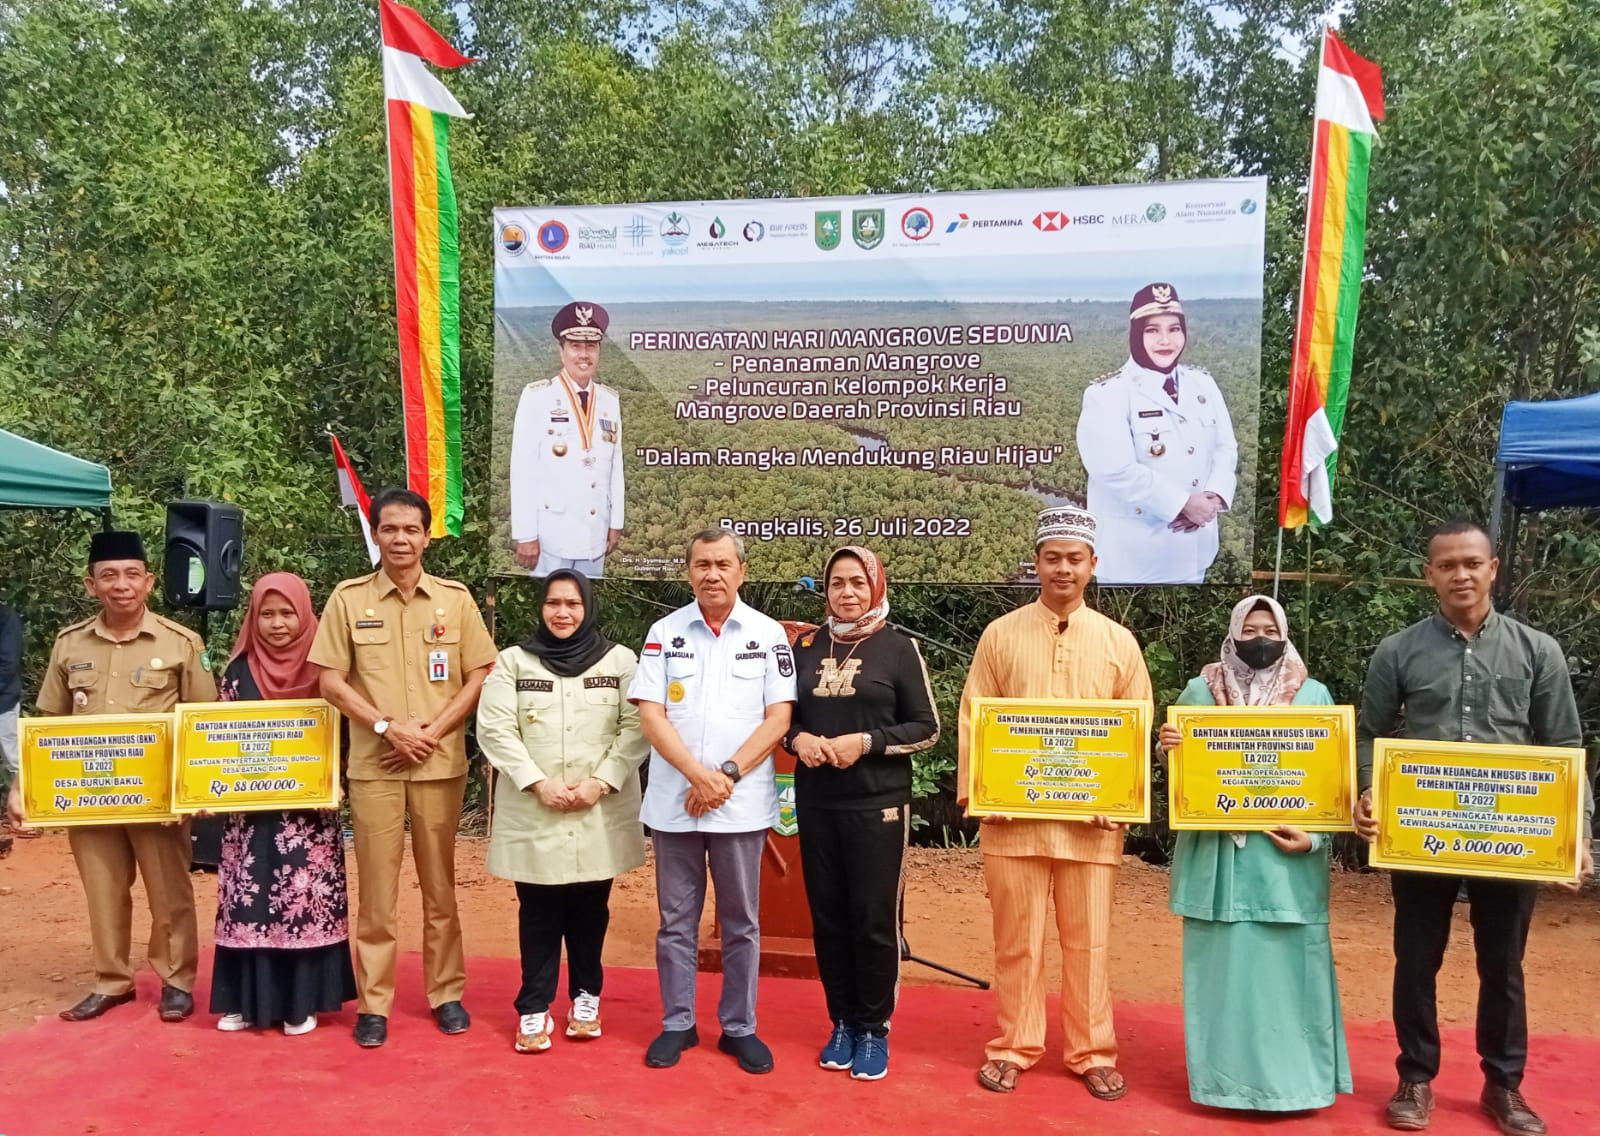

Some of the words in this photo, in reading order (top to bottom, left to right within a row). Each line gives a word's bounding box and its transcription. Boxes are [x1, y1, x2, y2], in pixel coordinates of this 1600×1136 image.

[972, 218, 1023, 229] PERTAMINA
[1073, 214, 1104, 225] HSBC
[1111, 214, 1148, 225] MERA
[630, 331, 767, 350] PERINGATAN
[773, 330, 825, 349] HARI
[830, 326, 962, 348] MANGROVE
[968, 324, 1073, 344] SEDUNIA
[731, 355, 860, 373] Penanaman
[866, 353, 981, 375] Mangrove
[705, 377, 828, 396] Peluncuran
[834, 374, 944, 397] Kelompok
[950, 373, 1008, 397] Kerja
[675, 401, 787, 424] Mangrove
[792, 400, 871, 420] Daerah
[877, 399, 966, 418] Provinsi
[972, 398, 1022, 416] Riau
[717, 447, 797, 471] Rangka
[802, 446, 935, 470] Mendukung
[940, 446, 989, 465] Riau
[834, 518, 862, 536] 26
[867, 518, 907, 536] Juli
[913, 518, 971, 536] 2022
[812, 657, 863, 698] M
[195, 721, 227, 731] BANTUAN
[229, 720, 266, 730] KEUANGAN
[267, 720, 295, 729] KHUSUS
[997, 715, 1030, 724] BANTUAN
[1031, 715, 1069, 725] KEUANGAN
[1070, 716, 1100, 726] KHUSUS
[208, 732, 251, 742] PEMERINTAH
[253, 731, 285, 740] PROVINSI
[287, 730, 303, 739] RIAU
[1009, 726, 1054, 736] PEMERINTAH
[1055, 727, 1090, 737] PROVINSI
[1091, 728, 1108, 737] RIAU
[1193, 729, 1229, 738] BANTUAN
[1230, 729, 1271, 738] KEUANGAN
[1272, 729, 1304, 738] KHUSUS
[39, 737, 70, 748] BANTUAN
[72, 736, 107, 746] KEUANGAN
[108, 735, 136, 745] KHUSUS
[252, 742, 270, 751] 2022
[1055, 738, 1074, 747] 2022
[1207, 742, 1256, 751] PEMERINTAH
[1257, 742, 1294, 751] PROVINSI
[1295, 741, 1314, 751] RIAU
[52, 750, 94, 760] PEMERINTAH
[95, 749, 127, 759] PROVINSI
[128, 748, 144, 757] RIAU
[1257, 754, 1277, 763] 2022
[95, 761, 113, 771] 2022
[189, 758, 221, 766] BANTUAN
[222, 757, 266, 765] PENYERTAAN
[1253, 769, 1306, 777] OPERASIONAL
[1401, 764, 1442, 776] BANTUAN
[1443, 766, 1489, 779] KEUANGAN
[1491, 769, 1527, 781] KHUSUS
[55, 779, 78, 788] DESA
[80, 778, 111, 787] BURUK
[114, 777, 144, 786] BAKUL
[1416, 779, 1471, 791] PEMERINTAH
[1472, 781, 1514, 793] PROVINSI
[1516, 784, 1538, 795] RIAU
[1472, 795, 1495, 806] 2022
[1397, 807, 1439, 818] BANTUAN
[1441, 810, 1504, 822] PENINGKATAN
[1506, 814, 1556, 825] KAPASITAS
[1400, 818, 1477, 831] KEWIRAUSAHAAN
